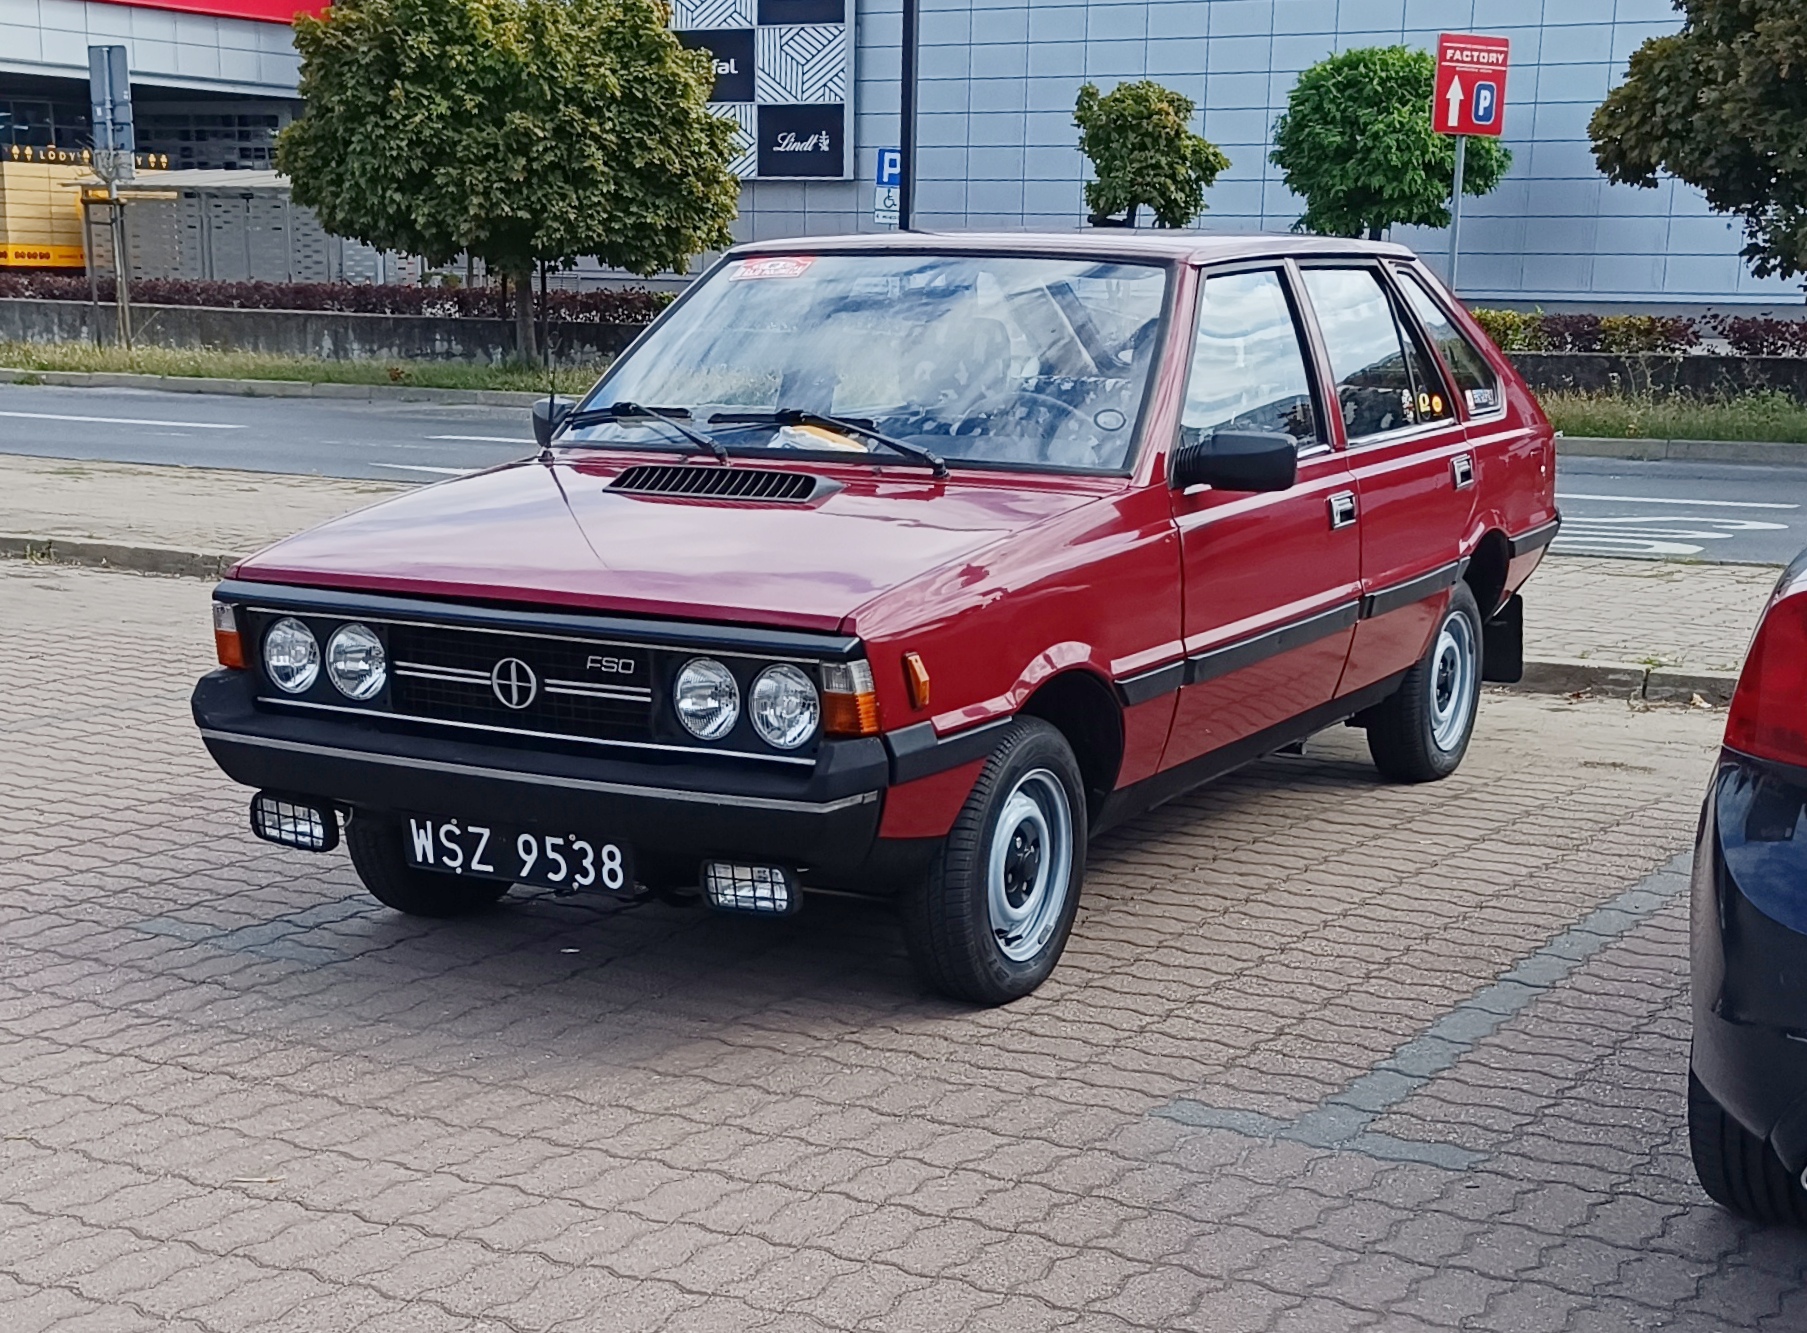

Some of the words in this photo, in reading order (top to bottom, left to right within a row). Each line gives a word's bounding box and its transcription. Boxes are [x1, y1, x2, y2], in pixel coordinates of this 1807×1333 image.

[1446, 49, 1505, 64] FACTORY
[1478, 89, 1492, 116] P
[772, 132, 819, 151] Lindt
[39, 150, 76, 161] LODY
[883, 152, 901, 182] P
[586, 655, 635, 674] FSO
[409, 818, 495, 873] WSZ
[516, 833, 625, 890] 9538
